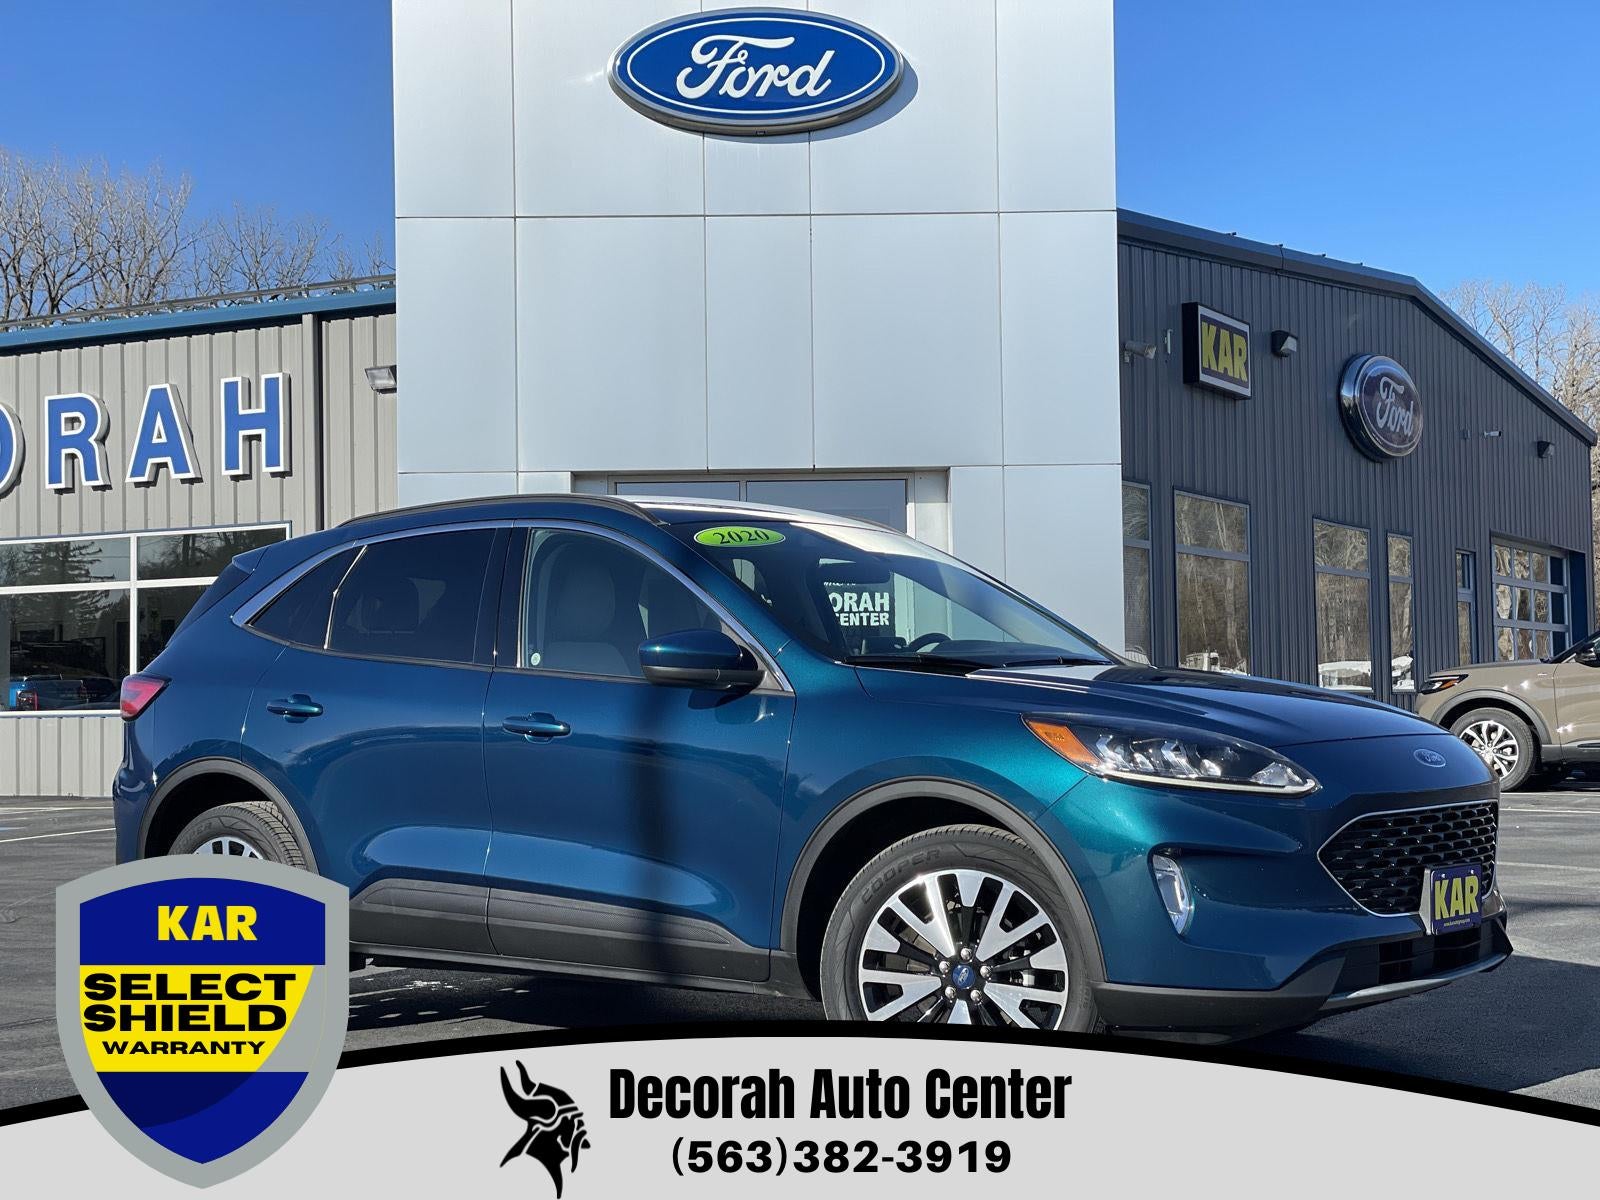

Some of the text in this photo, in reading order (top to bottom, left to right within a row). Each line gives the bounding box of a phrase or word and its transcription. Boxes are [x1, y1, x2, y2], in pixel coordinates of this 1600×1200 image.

[676, 34, 836, 99] Ford
[1201, 320, 1248, 383] KAR
[1376, 376, 1414, 437] Ford
[712, 530, 770, 544] 2020
[834, 612, 890, 626] ENTER
[861, 849, 940, 904] COOPER
[1434, 875, 1479, 920] KAR
